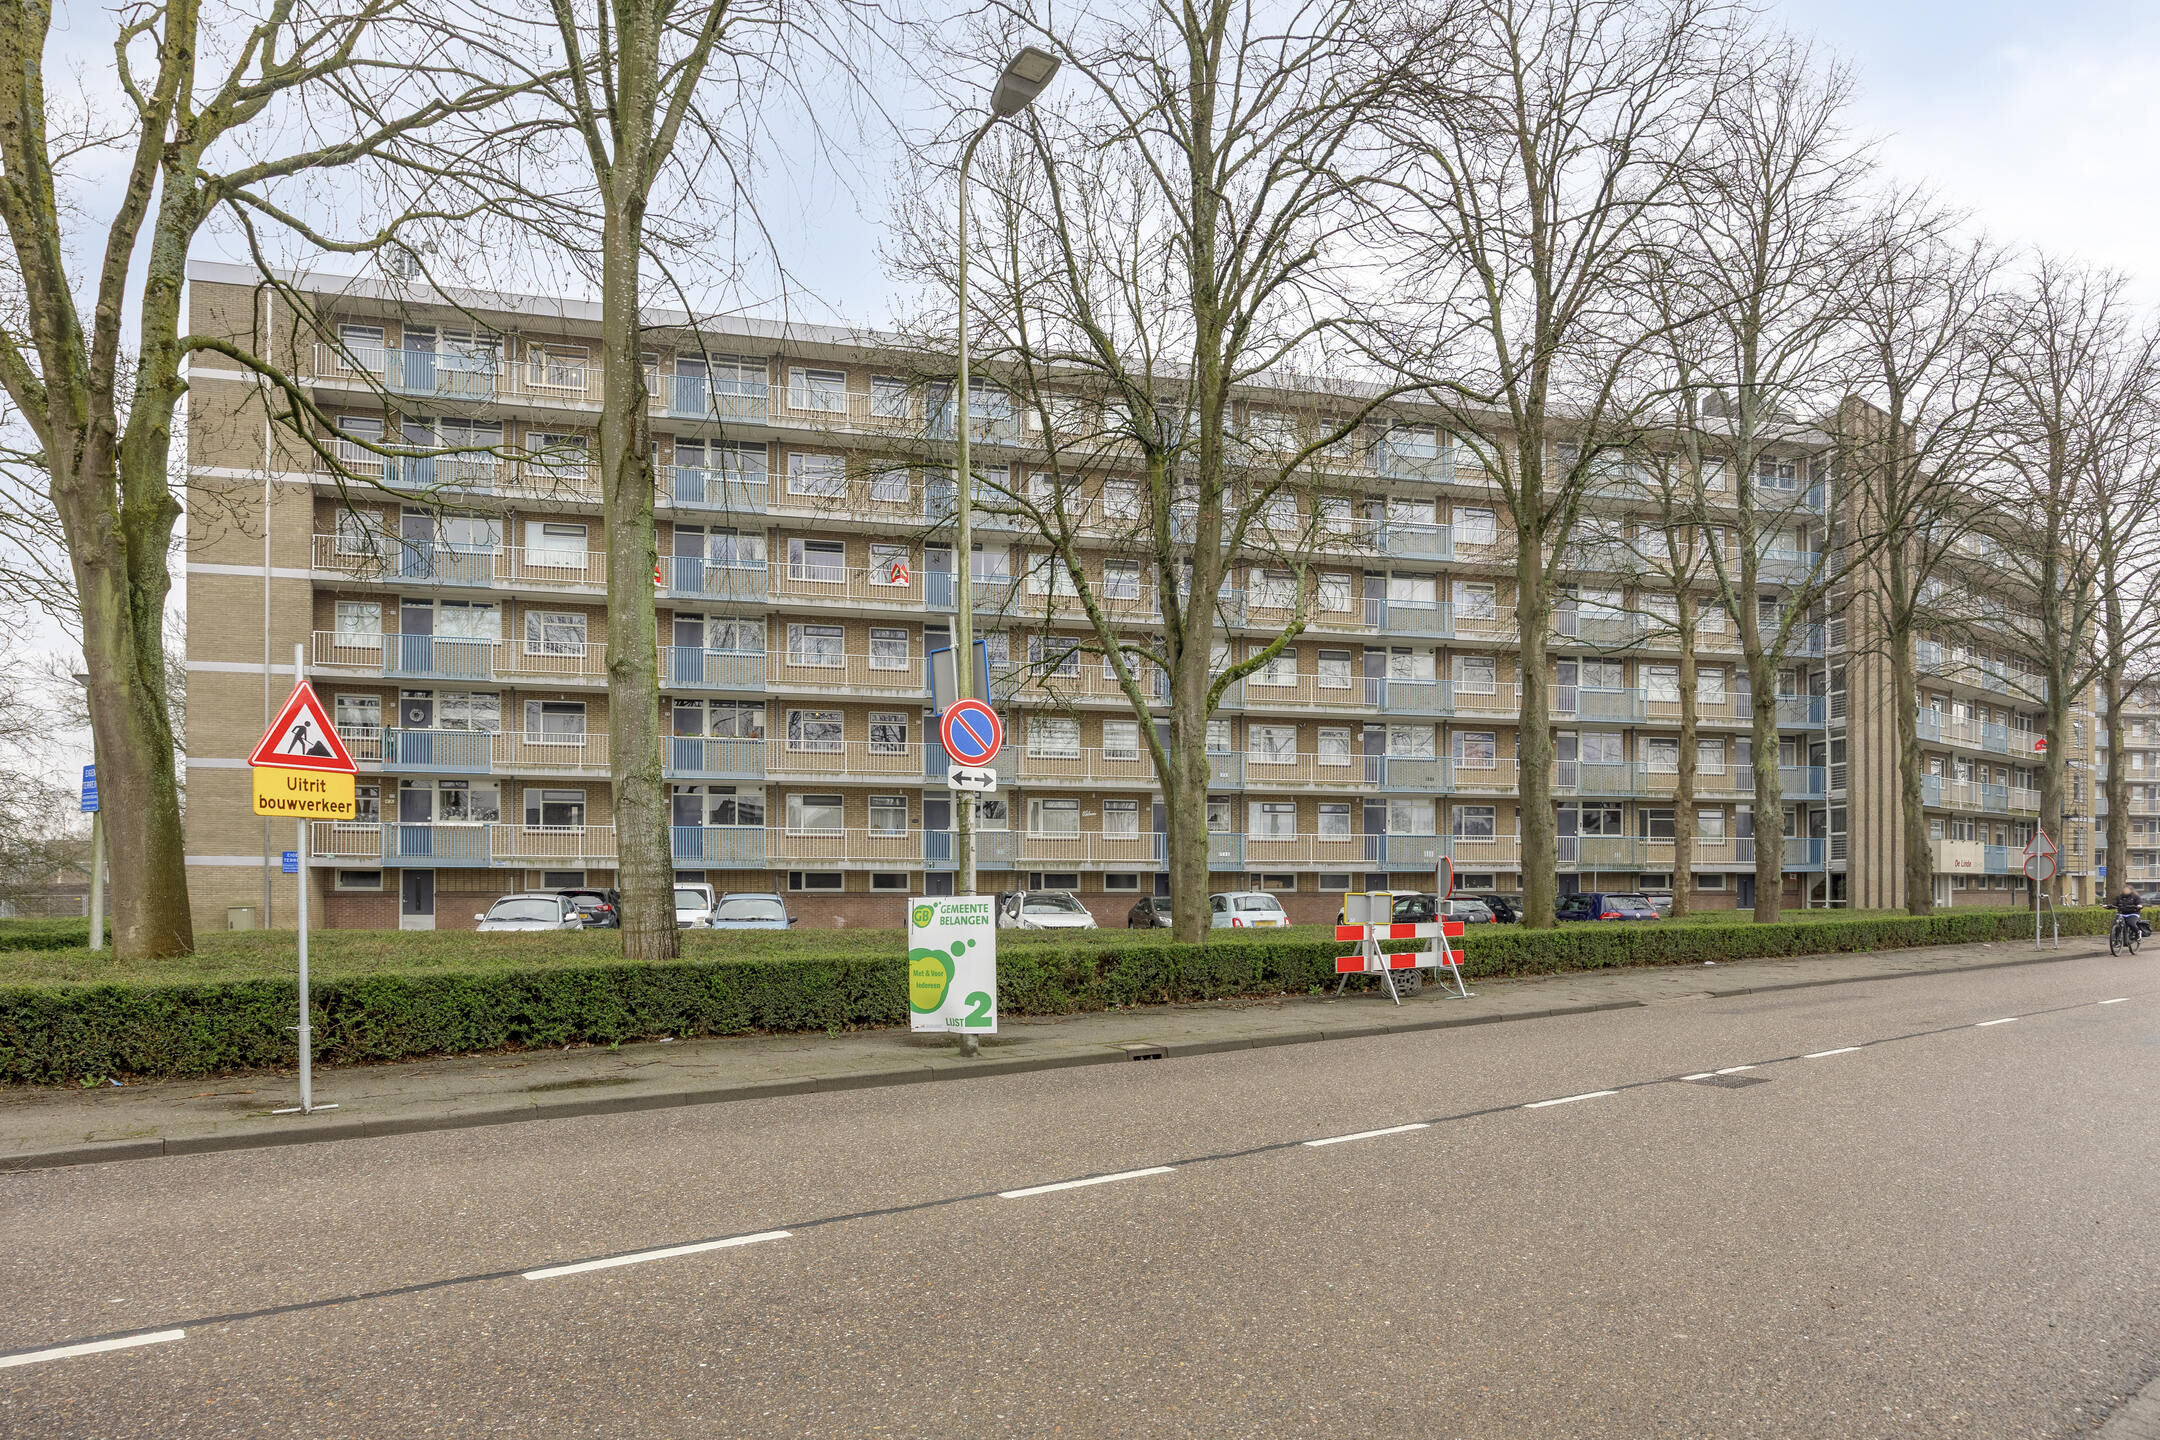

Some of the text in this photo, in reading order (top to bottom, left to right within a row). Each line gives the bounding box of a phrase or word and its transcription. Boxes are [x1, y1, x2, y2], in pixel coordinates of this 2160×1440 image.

[287, 777, 326, 793] Uitrit
[259, 795, 352, 813] bouwverkeer
[940, 904, 989, 913] GEMEENTE
[914, 910, 929, 922] GB
[940, 916, 989, 926] BELANGEN
[913, 969, 924, 977] Met
[945, 991, 993, 1027] LIJST 2
